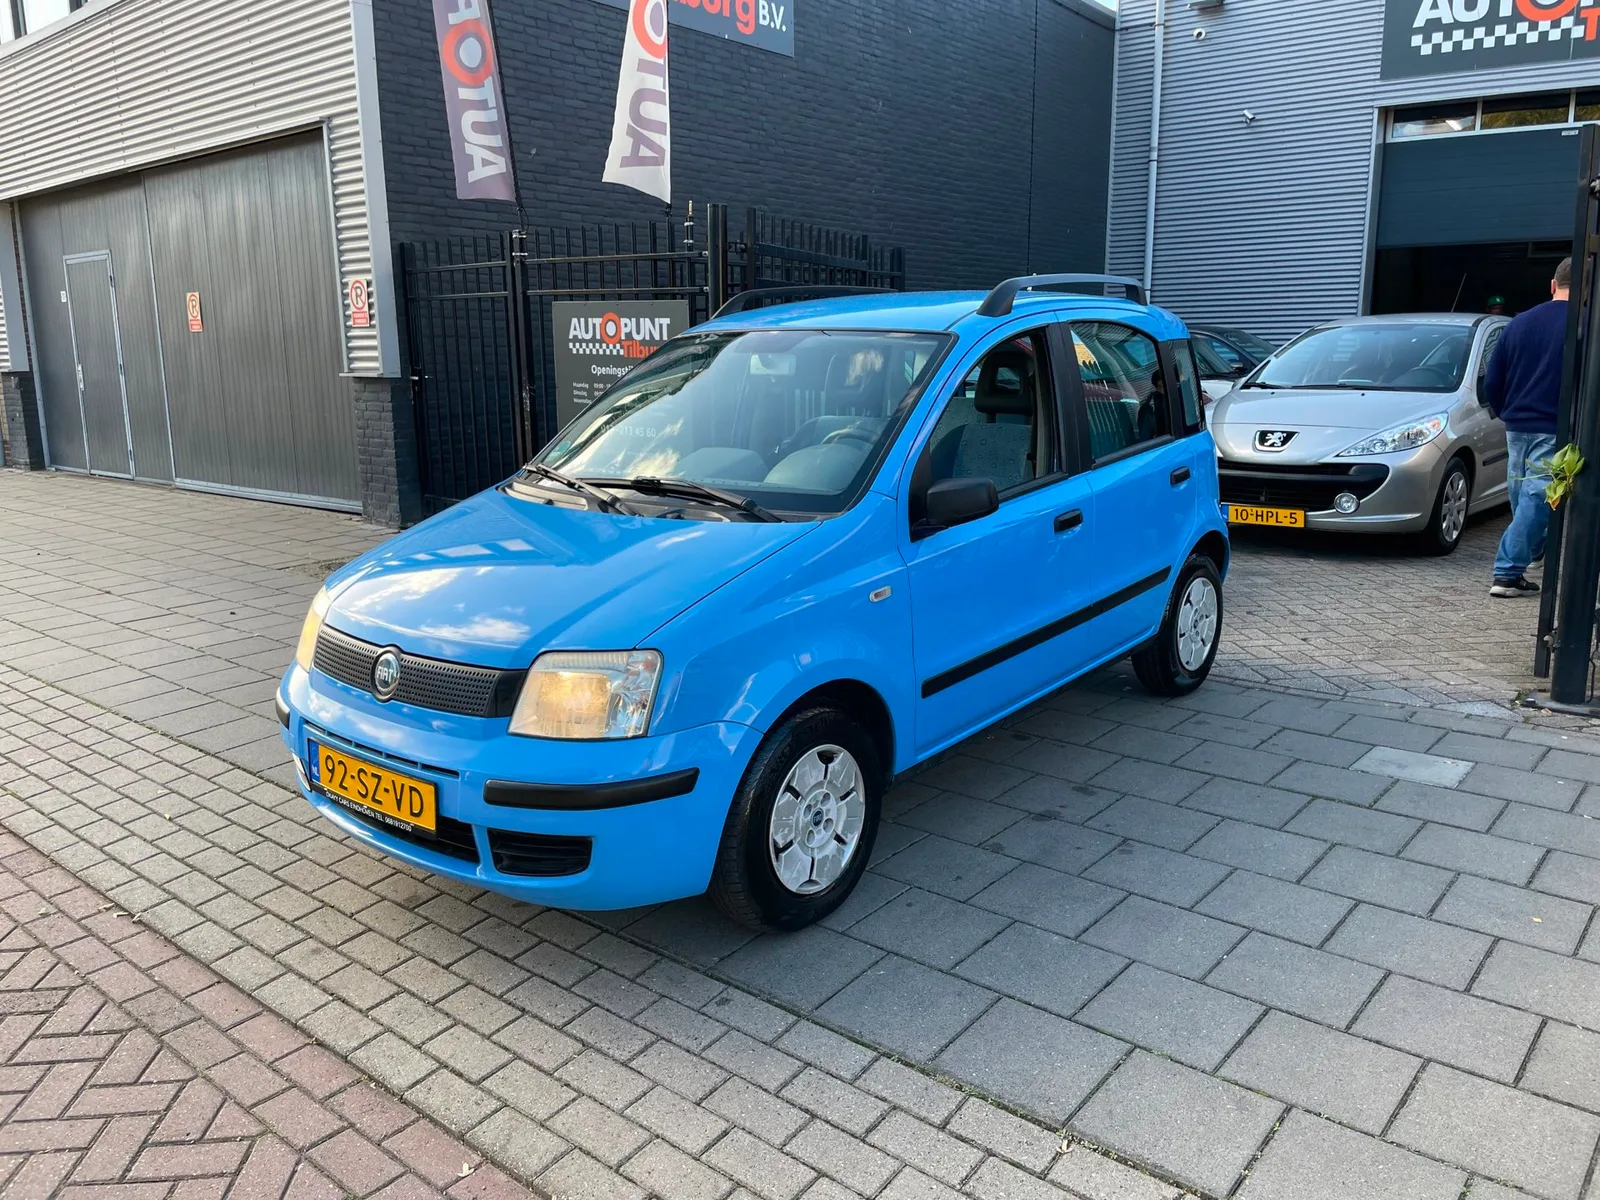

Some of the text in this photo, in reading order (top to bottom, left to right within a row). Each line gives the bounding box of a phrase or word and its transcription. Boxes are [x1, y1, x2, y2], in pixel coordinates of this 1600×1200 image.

[759, 0, 787, 32] B.V.
[569, 312, 671, 345] AUTOPUNT
[591, 364, 634, 377] Openingst
[646, 427, 657, 438] 60
[1234, 508, 1298, 525] 10-HPL-5
[377, 665, 394, 683] FIAT
[325, 754, 424, 818] 92-SZ-VD
